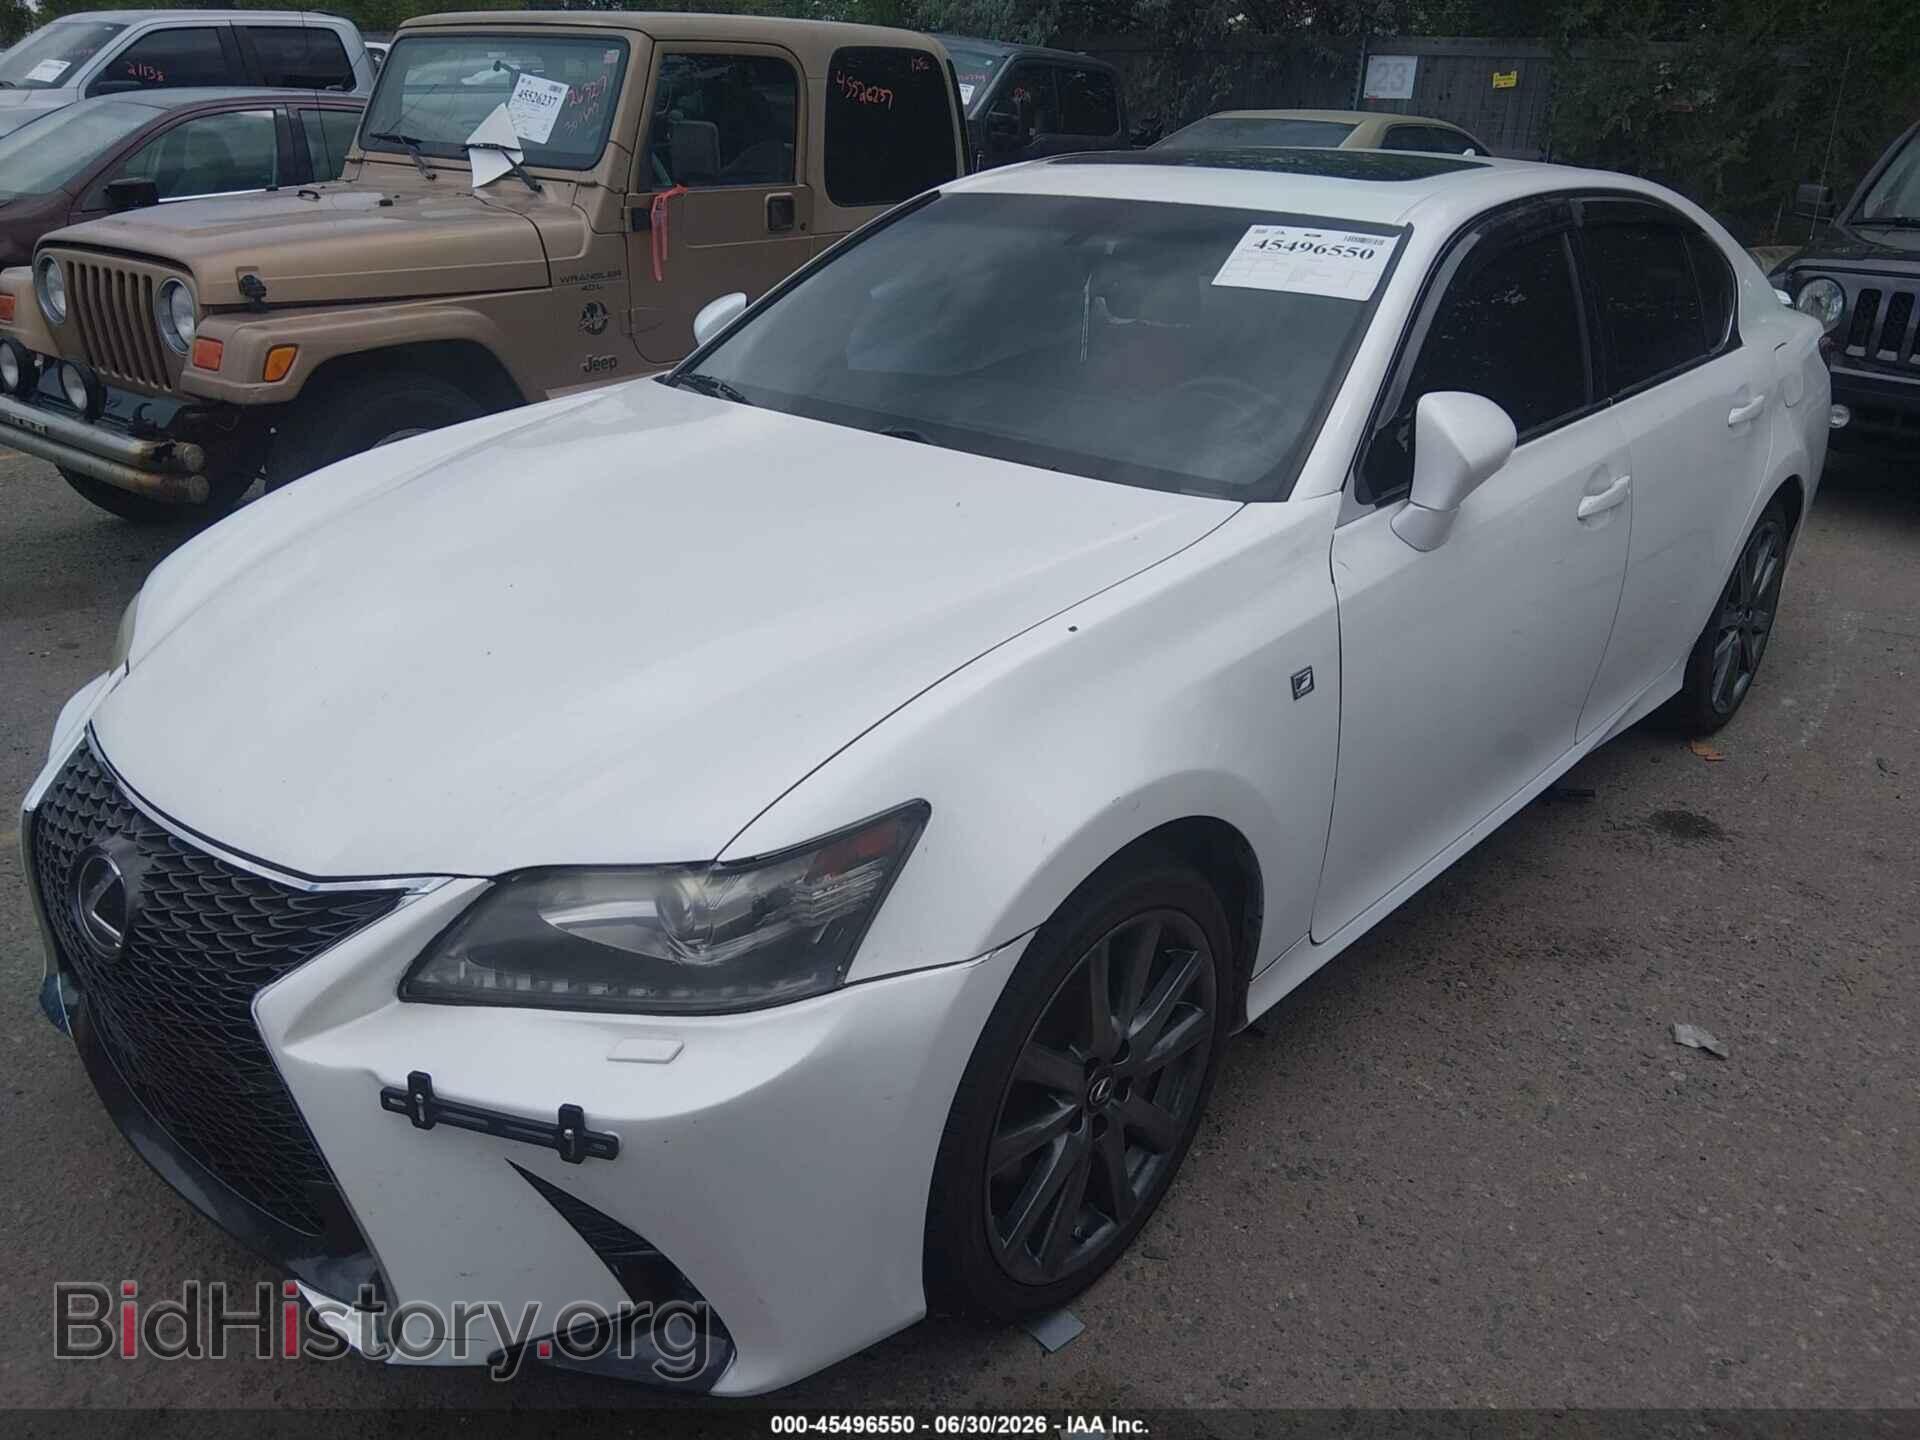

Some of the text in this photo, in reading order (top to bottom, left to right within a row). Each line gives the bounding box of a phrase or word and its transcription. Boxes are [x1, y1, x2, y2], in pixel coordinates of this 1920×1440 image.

[517, 88, 558, 108] 45526237
[1253, 237, 1376, 261] 45496550
[582, 354, 617, 373] Jeep
